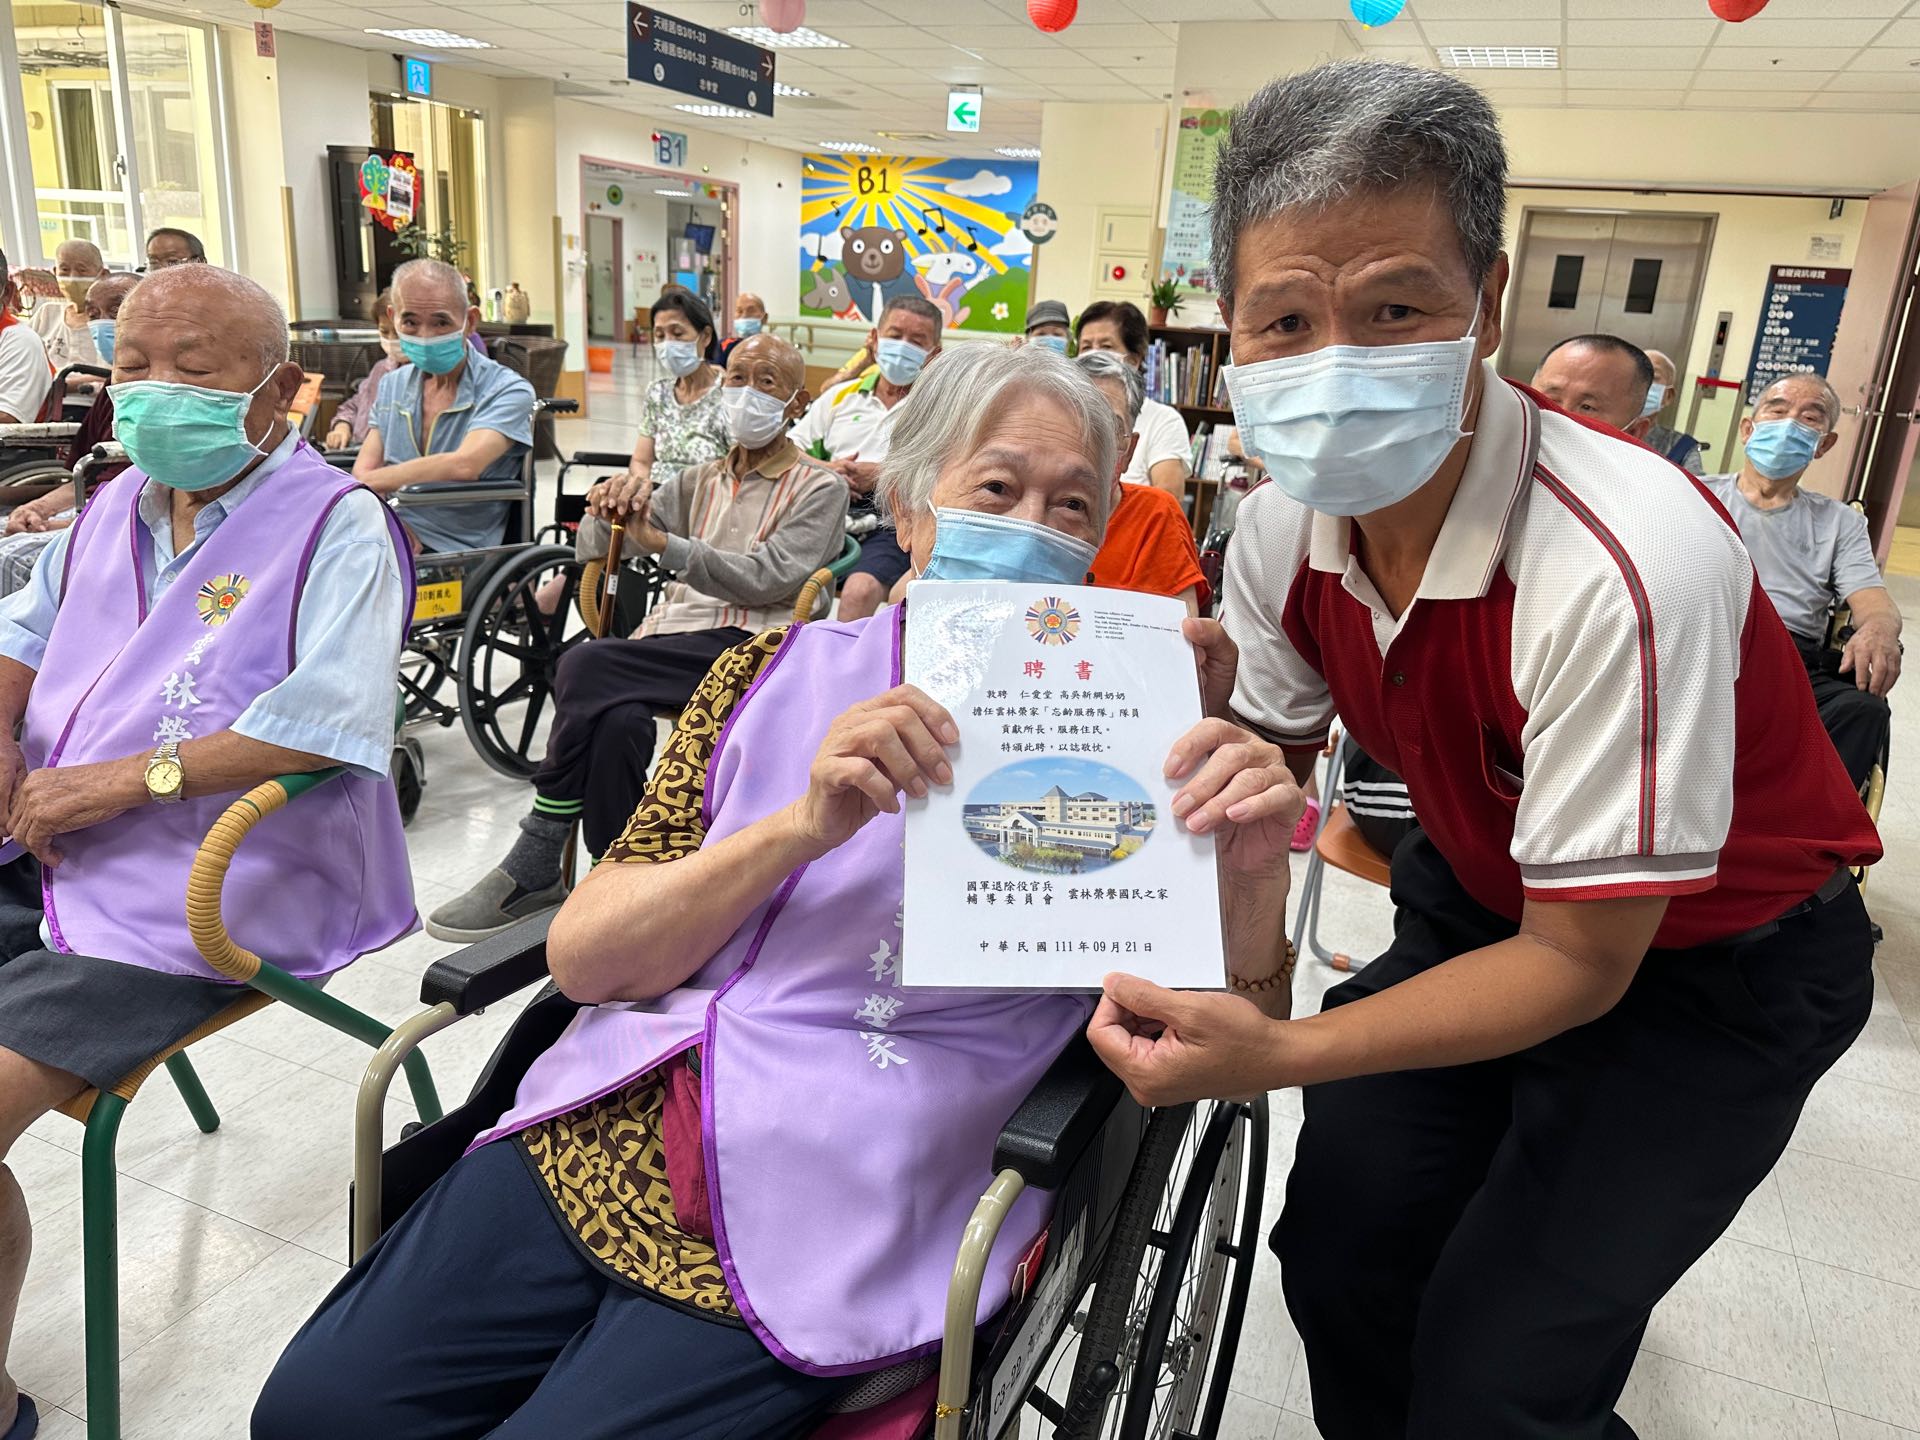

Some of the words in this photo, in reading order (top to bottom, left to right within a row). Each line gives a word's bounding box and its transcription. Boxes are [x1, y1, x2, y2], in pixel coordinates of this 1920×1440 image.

[659, 135, 683, 166] B1
[858, 167, 891, 195] B1
[986, 689, 1008, 700] 敦聘
[1019, 689, 1053, 700] 仁愛堂
[966, 880, 1054, 892] 國軍退除役官兵
[1068, 887, 1169, 900] 雲林榮譽國民之家
[966, 893, 1054, 905] 輔導委員會
[853, 897, 909, 1070] 林榮家
